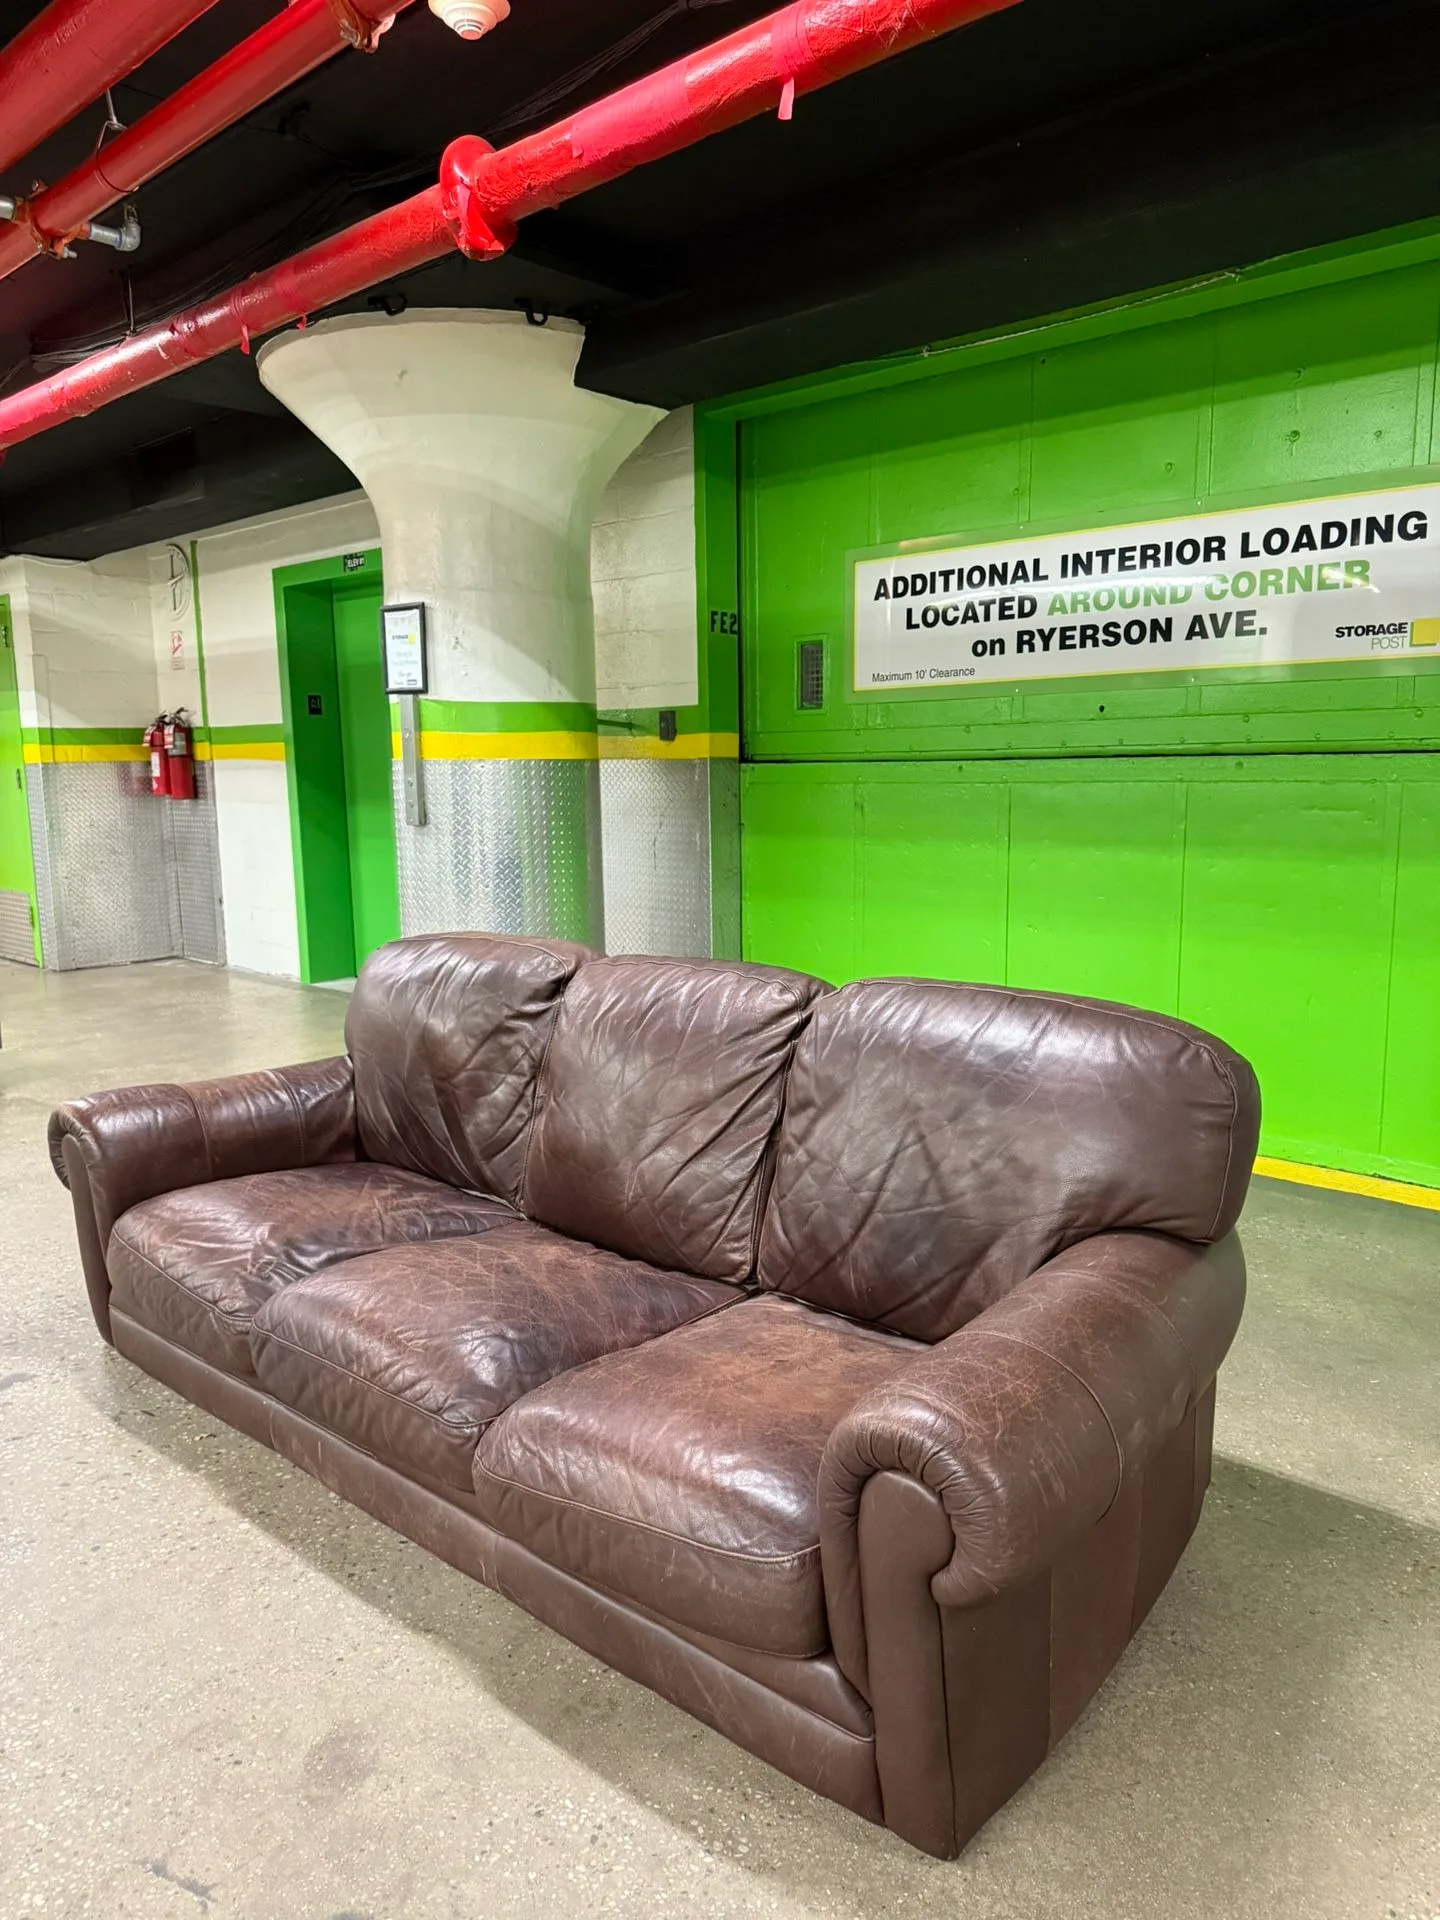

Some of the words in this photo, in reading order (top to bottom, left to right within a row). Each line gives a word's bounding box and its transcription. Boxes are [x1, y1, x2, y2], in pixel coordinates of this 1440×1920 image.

[873, 555, 1049, 601] ADDITIONAL
[1060, 535, 1226, 579] INTERIOR
[1240, 510, 1428, 559] LOADING
[906, 595, 1038, 630] LOCATED
[1047, 579, 1193, 616] AROUND
[1204, 559, 1371, 601] CORNER
[710, 610, 738, 635] FE2
[971, 637, 1005, 658] on
[1016, 616, 1173, 654] RYERSON
[1185, 609, 1268, 641] AVE.
[1335, 622, 1409, 638] STORAGE
[1370, 635, 1408, 650] POST
[872, 671, 913, 683] Maximum
[929, 667, 976, 679] Clearance
